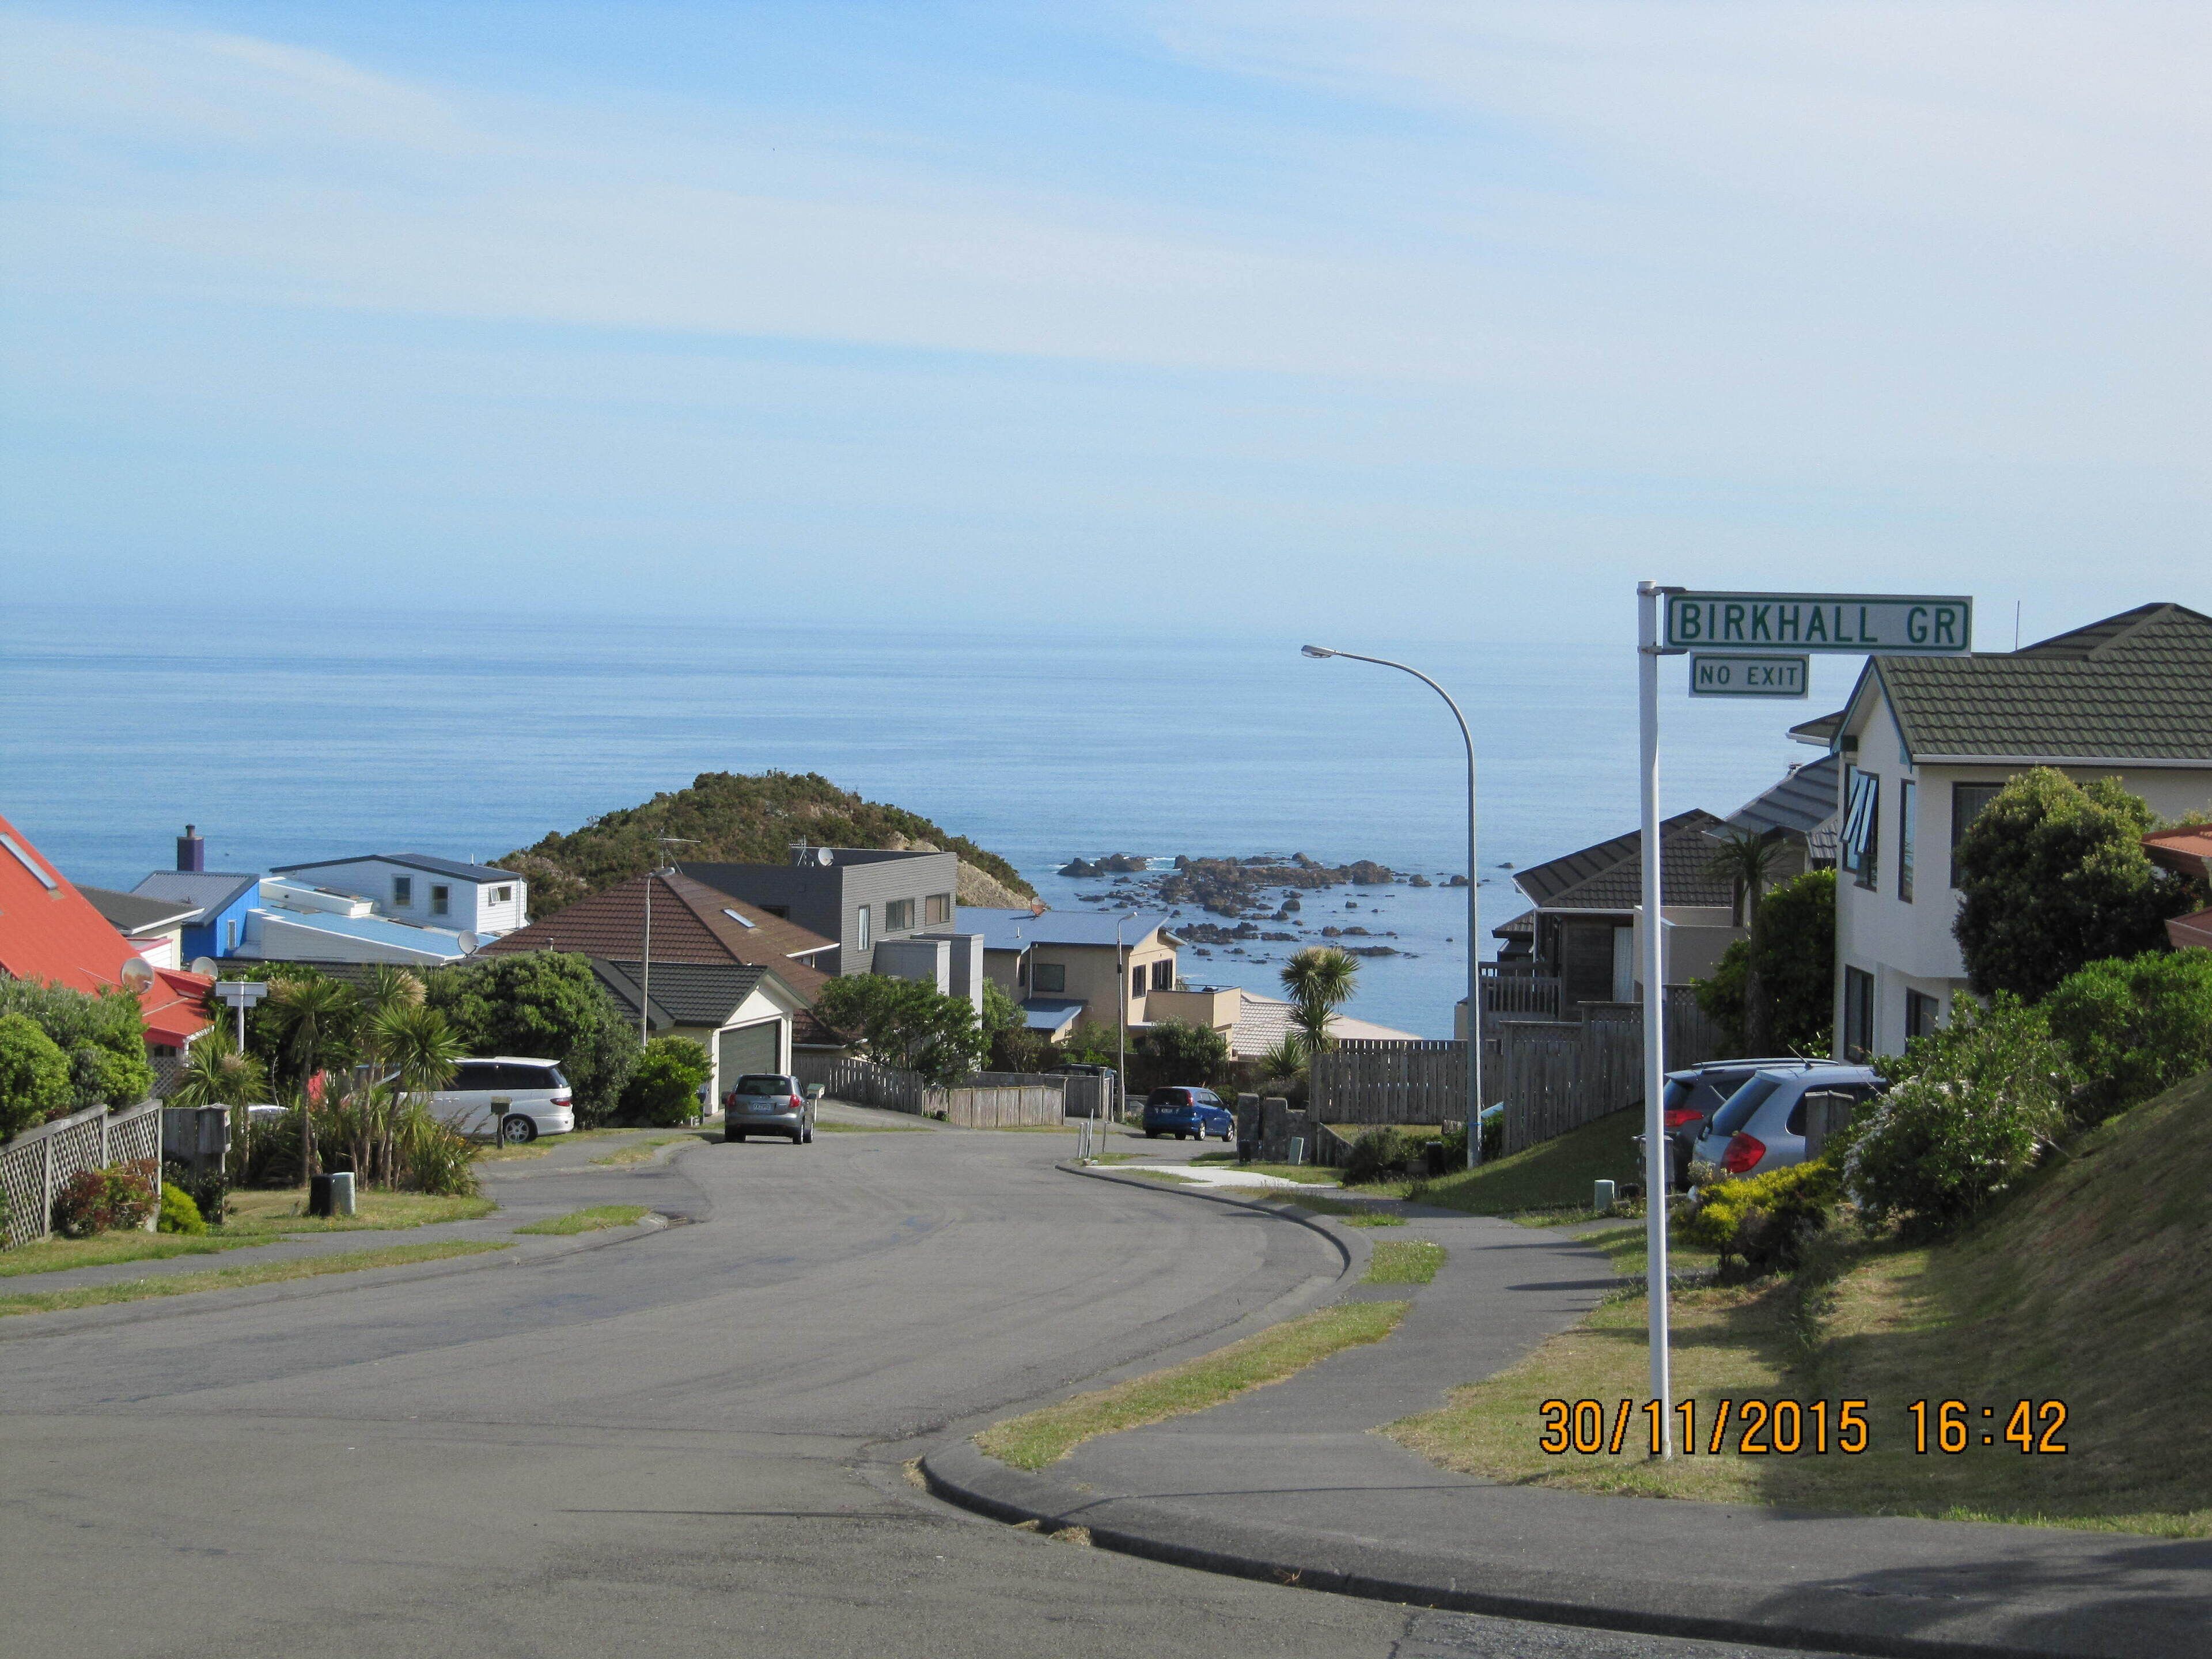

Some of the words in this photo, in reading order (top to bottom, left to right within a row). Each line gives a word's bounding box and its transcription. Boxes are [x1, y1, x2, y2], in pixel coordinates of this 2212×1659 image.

[1680, 603, 1878, 643] BIRKHALL
[1907, 606, 1956, 644] GR
[1699, 665, 1730, 685] NO
[1747, 666, 1798, 686] EXIT
